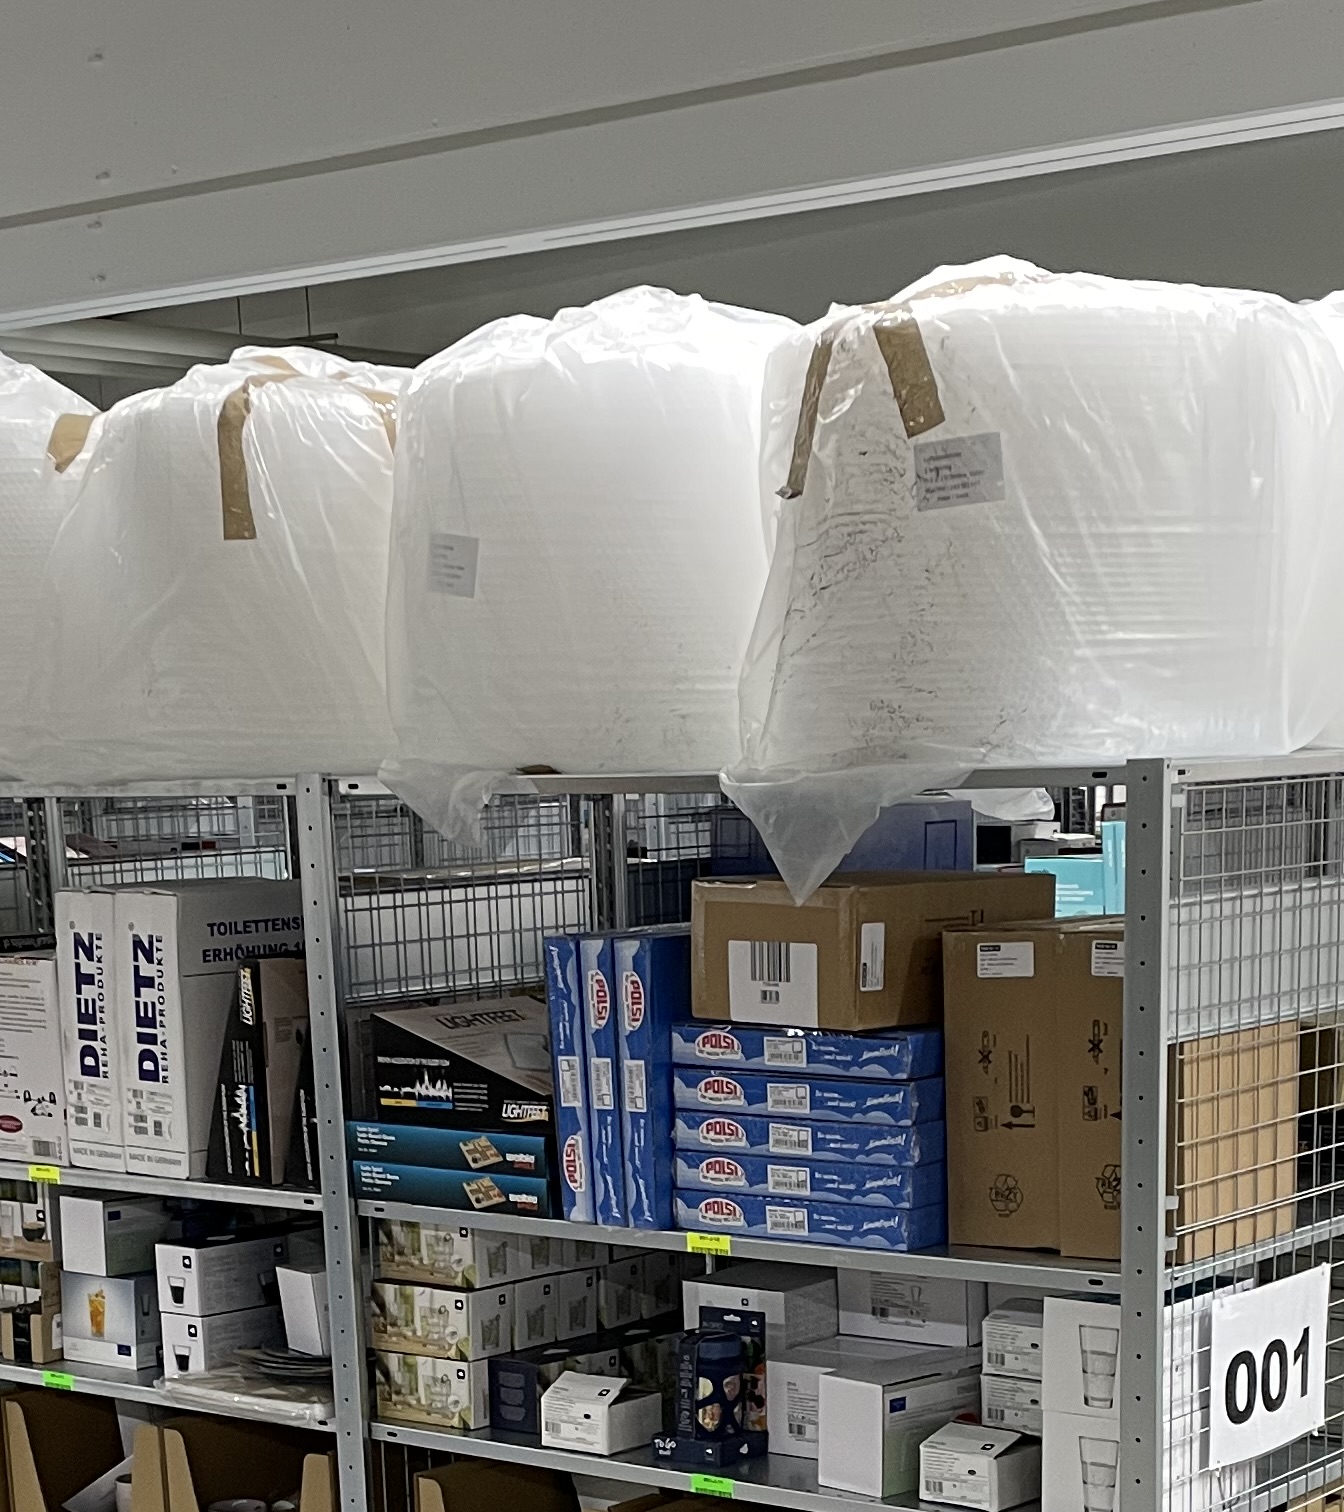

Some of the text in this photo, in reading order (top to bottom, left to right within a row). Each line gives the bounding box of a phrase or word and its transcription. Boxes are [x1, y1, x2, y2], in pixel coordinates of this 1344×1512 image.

[73, 931, 101, 1078] DIETZ
[95, 933, 109, 1079] REHA-PRODUKTE
[132, 933, 160, 1083] DIETZ
[155, 935, 169, 1084] REHA-PRODUKTE
[434, 1009, 527, 1030] LIGHTFEET
[596, 978, 607, 1021] POLSI
[630, 979, 641, 1022] POLSI
[701, 1033, 736, 1051] POLSI
[703, 1079, 738, 1096] POLSI
[705, 1121, 740, 1138] POLSI
[565, 1143, 578, 1183] POLSI
[705, 1160, 739, 1177] POLSI
[704, 1200, 737, 1217] POLSI
[1224, 1326, 1311, 1425] 001
